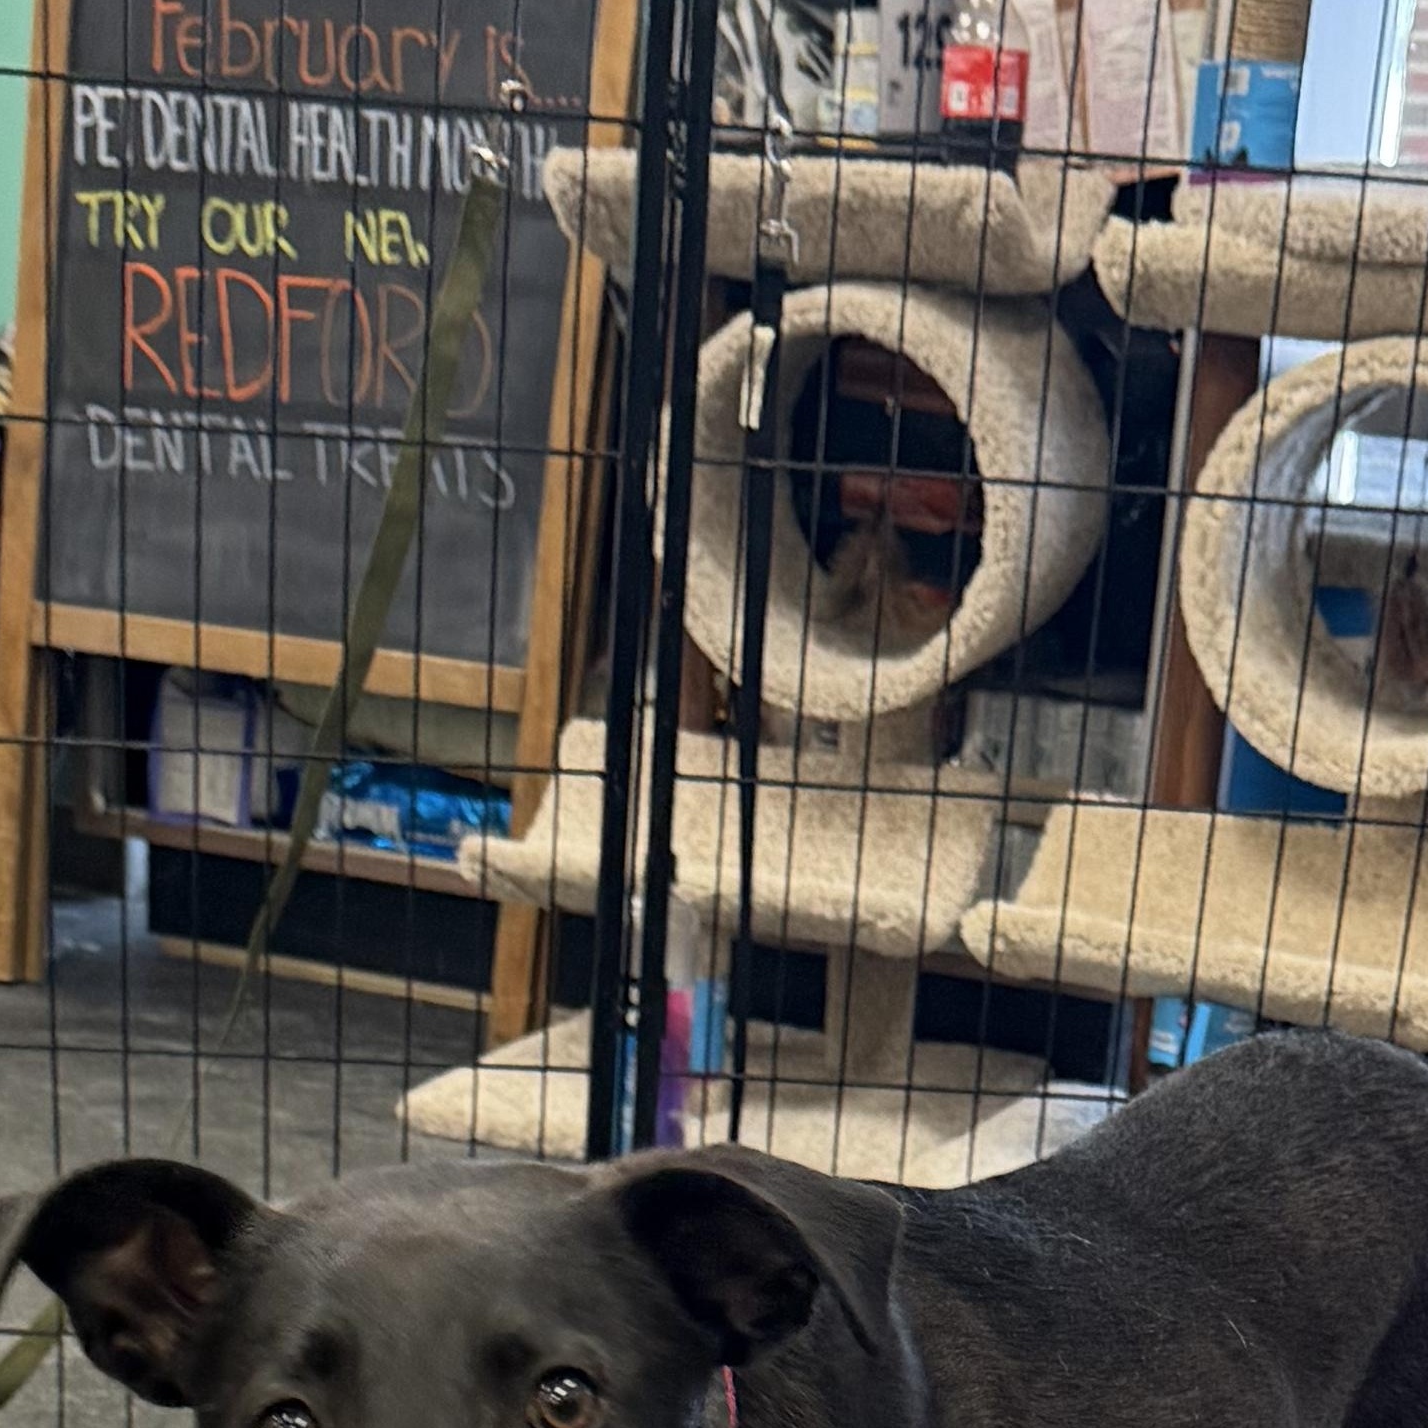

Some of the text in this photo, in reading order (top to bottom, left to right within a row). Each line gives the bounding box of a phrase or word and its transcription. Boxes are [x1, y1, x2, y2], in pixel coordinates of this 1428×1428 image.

[152, 0, 460, 95] February
[141, 89, 279, 178] DENTAL
[286, 100, 413, 191] HEALTH
[74, 190, 166, 251] TRY
[201, 197, 299, 261] OUR
[84, 403, 293, 482] DENTAL
